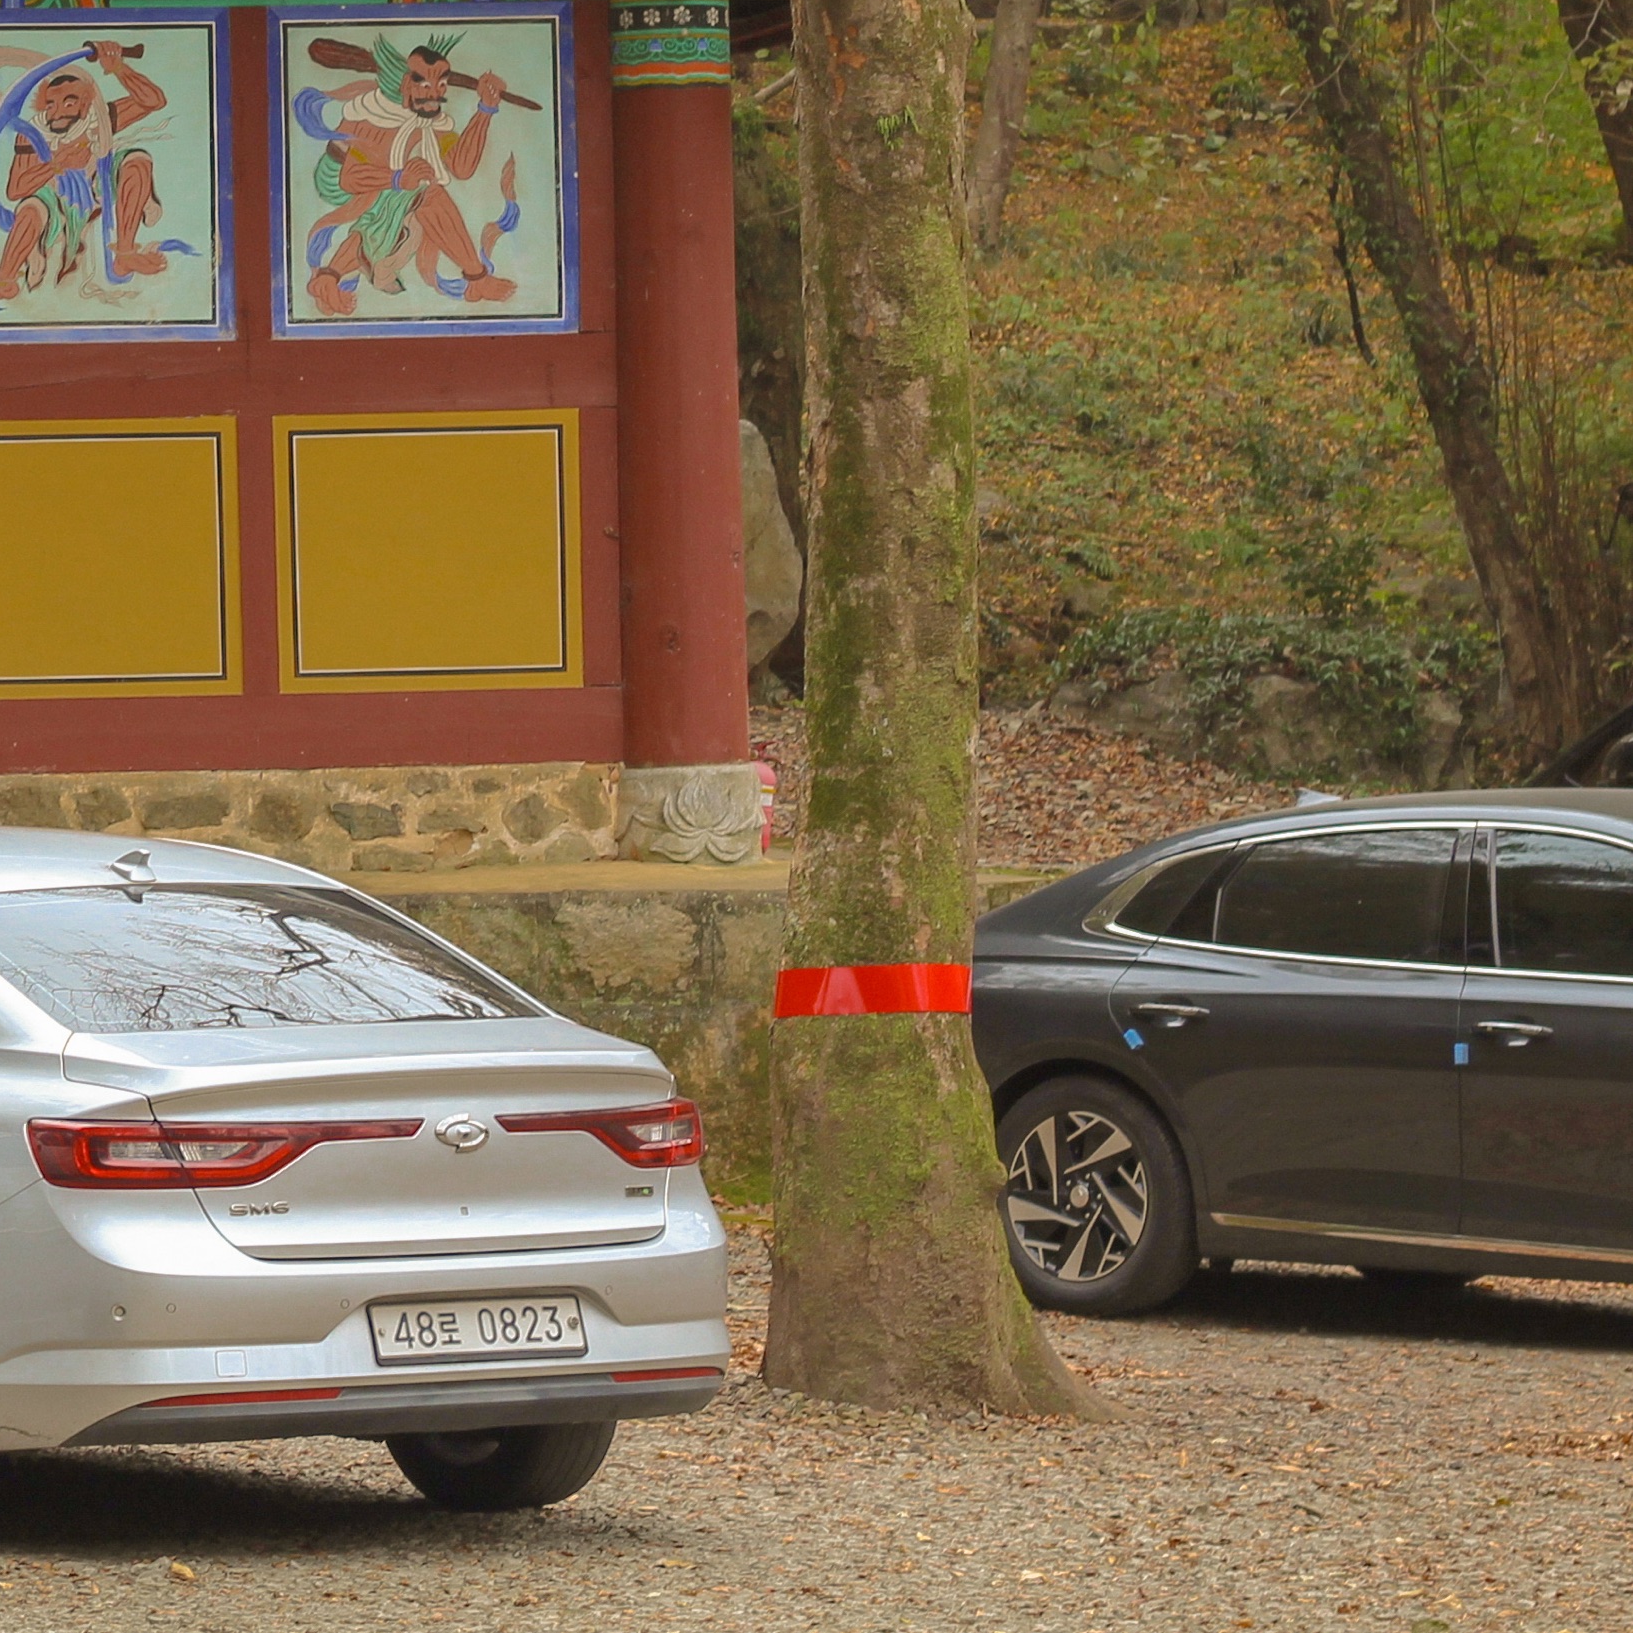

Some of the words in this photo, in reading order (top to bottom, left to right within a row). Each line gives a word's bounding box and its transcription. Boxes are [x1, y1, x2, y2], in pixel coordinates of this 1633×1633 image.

[229, 1201, 290, 1216] SM6
[393, 1311, 463, 1350] 48로
[477, 1305, 564, 1346] 0823
